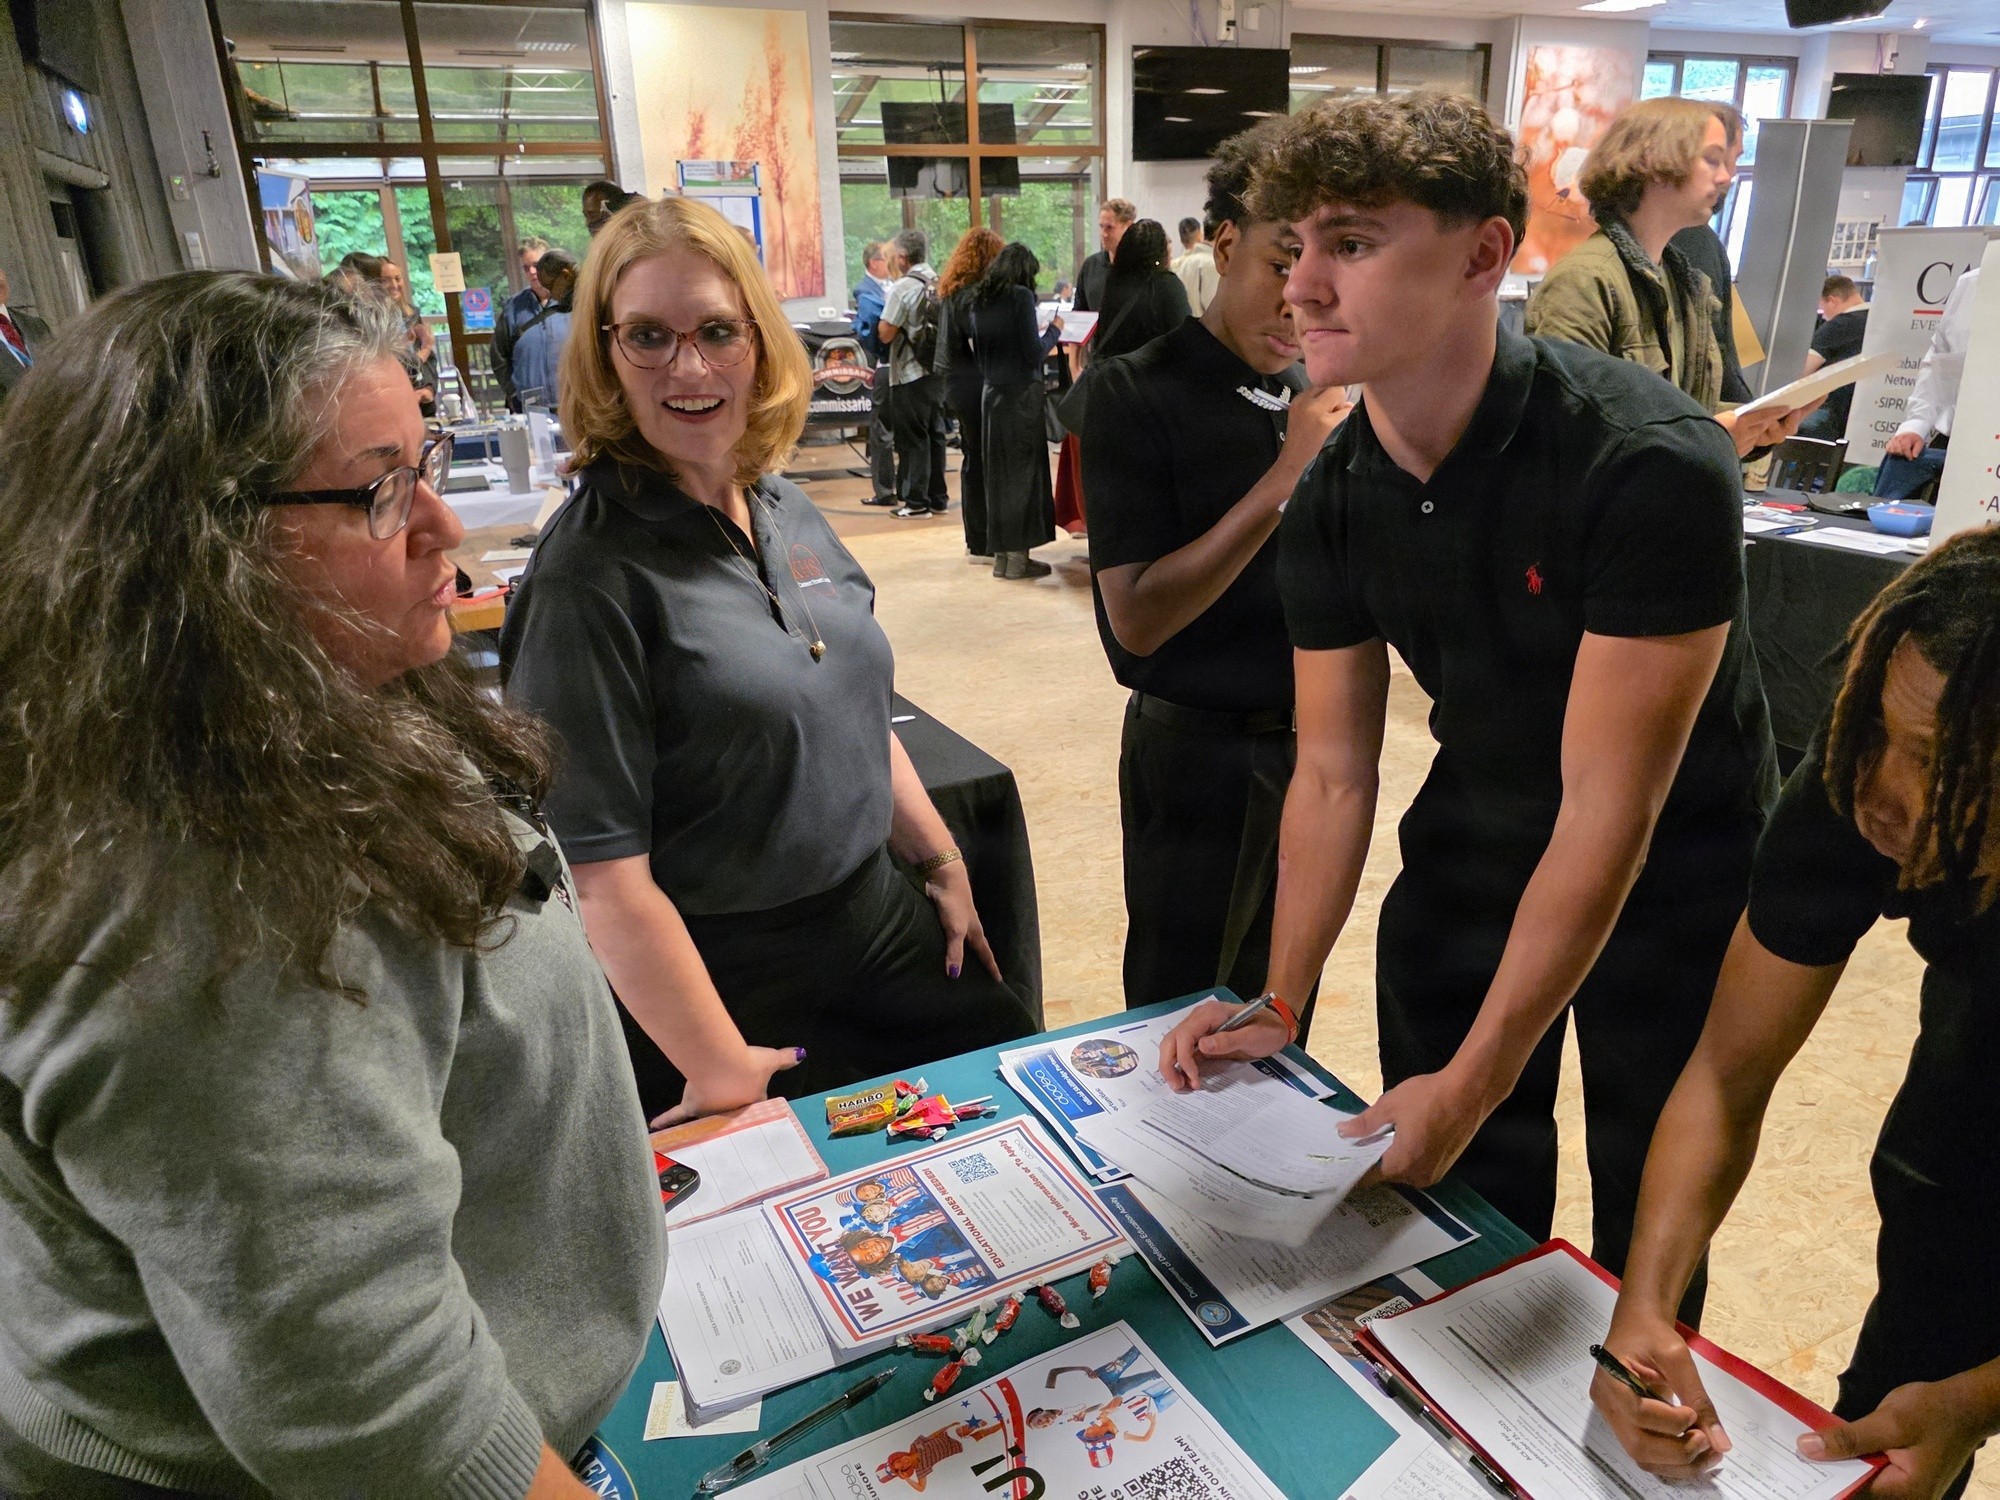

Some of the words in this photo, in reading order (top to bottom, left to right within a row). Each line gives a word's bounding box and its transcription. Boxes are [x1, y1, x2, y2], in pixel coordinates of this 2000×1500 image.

[837, 1092, 884, 1110] HARIBO
[997, 1138, 1018, 1158] Apply
[1012, 1157, 1023, 1167] To
[920, 1167, 949, 1196] NEEDED!
[1027, 1172, 1064, 1210] Information
[943, 1195, 965, 1217] AIDES
[1060, 1209, 1080, 1228] More
[1108, 1195, 1129, 1215] Activity
[792, 1204, 836, 1242] YOU
[1075, 1228, 1091, 1241] For
[1122, 1212, 1149, 1239] Education
[960, 1216, 1006, 1269] EDUCATIONAL
[1142, 1237, 1167, 1262] Defense
[814, 1237, 866, 1289] WANT
[1166, 1265, 1199, 1299] Department
[844, 1286, 886, 1322] WE
[1173, 1434, 1201, 1465] TEAM!
[1518, 1439, 1551, 1468] September
[1198, 1463, 1220, 1487] OUR
